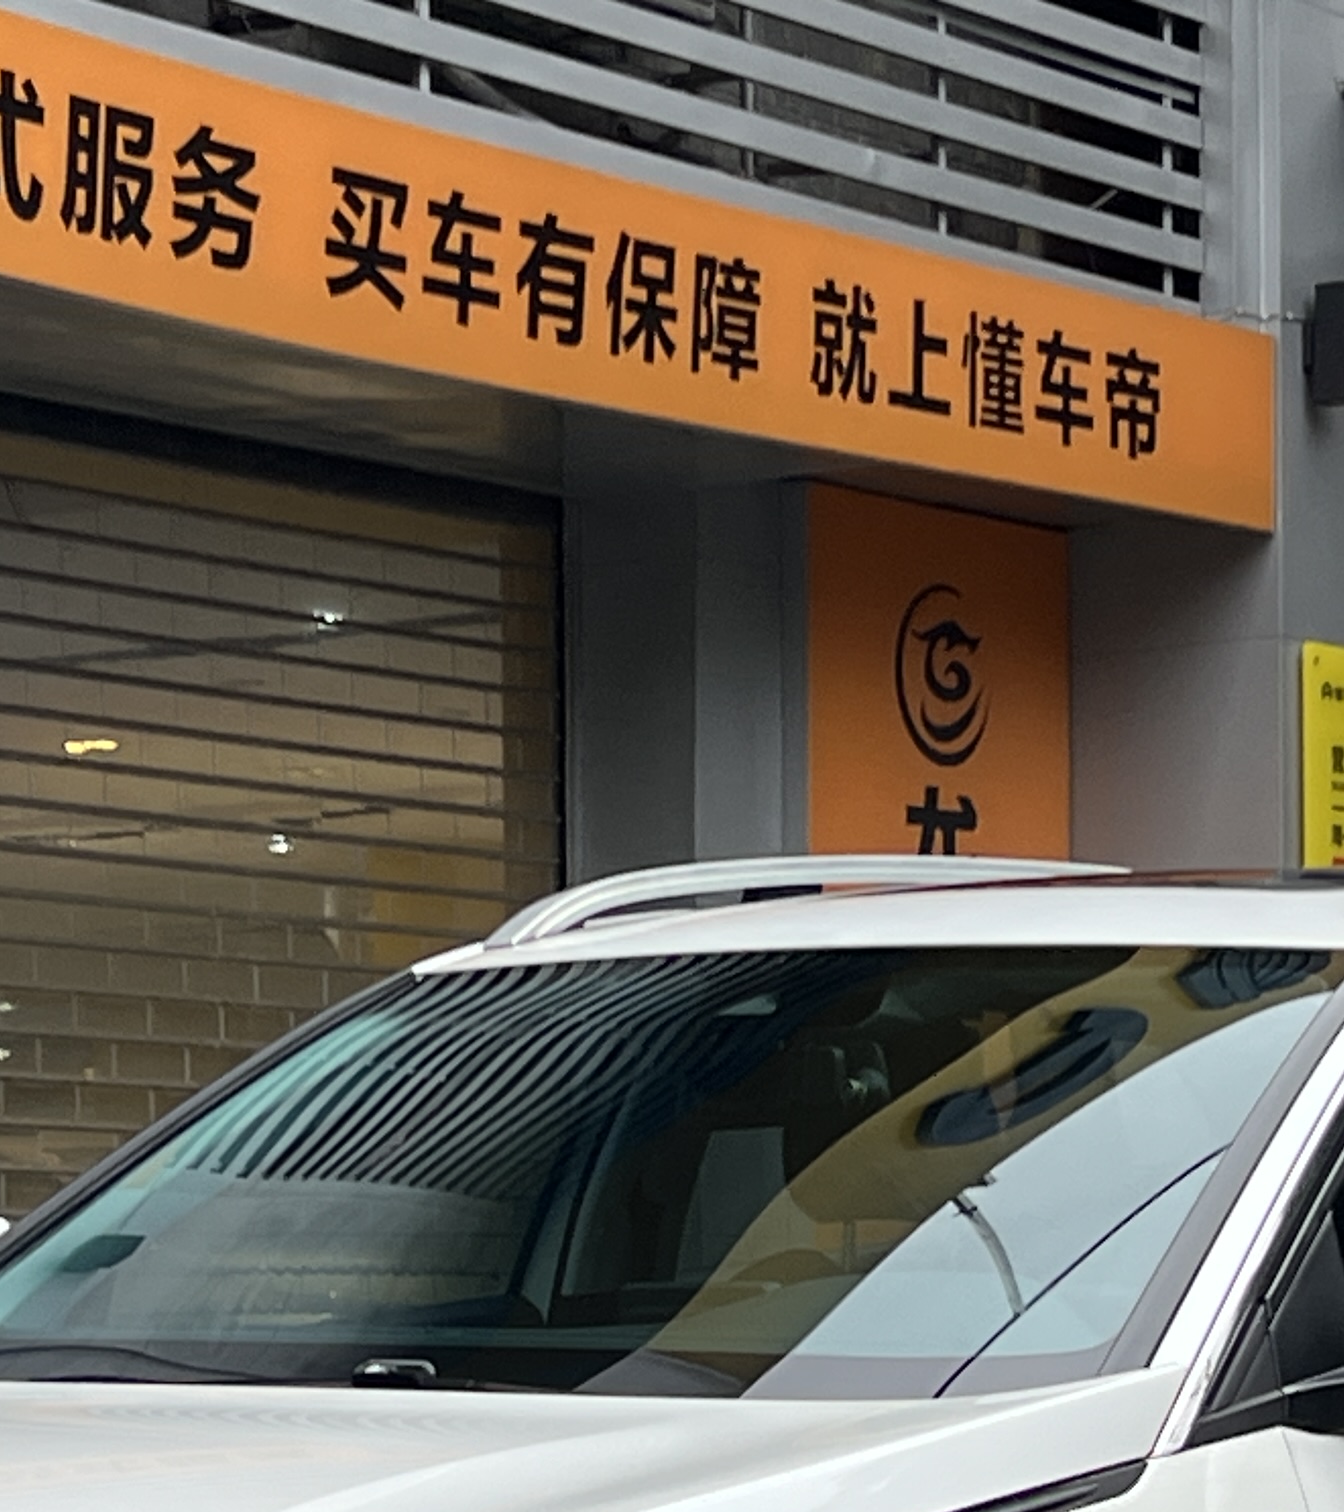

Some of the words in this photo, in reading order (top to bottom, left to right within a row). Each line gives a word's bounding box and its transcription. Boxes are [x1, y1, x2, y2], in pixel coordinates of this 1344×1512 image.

[324, 166, 762, 381] 买车有保障
[810, 279, 1162, 460] 就上懂车帝
